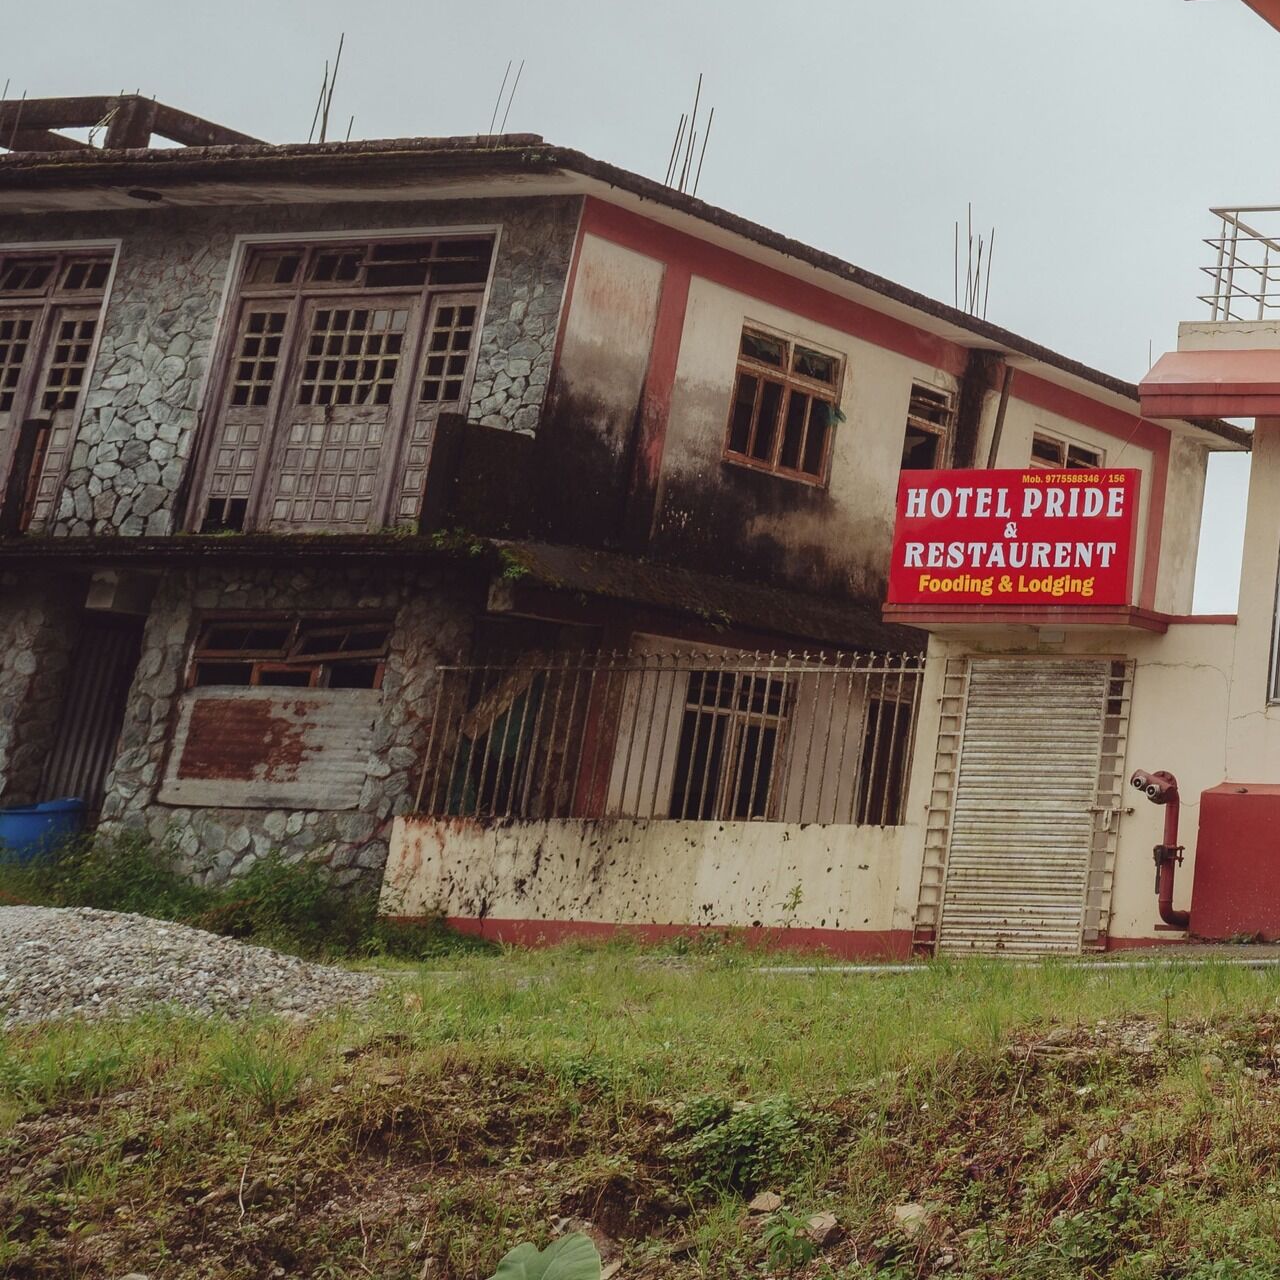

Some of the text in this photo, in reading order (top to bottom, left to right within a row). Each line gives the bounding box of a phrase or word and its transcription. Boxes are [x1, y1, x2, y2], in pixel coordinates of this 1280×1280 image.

[1022, 474, 1044, 483] Mob.
[1045, 474, 1099, 484] 9775588346
[1108, 474, 1125, 484] 156
[905, 486, 1125, 519] HOTEL PRIDE
[1003, 521, 1018, 539] &
[903, 542, 1116, 568] RESTAURENT
[919, 574, 1095, 597] Fooding & Lodging
